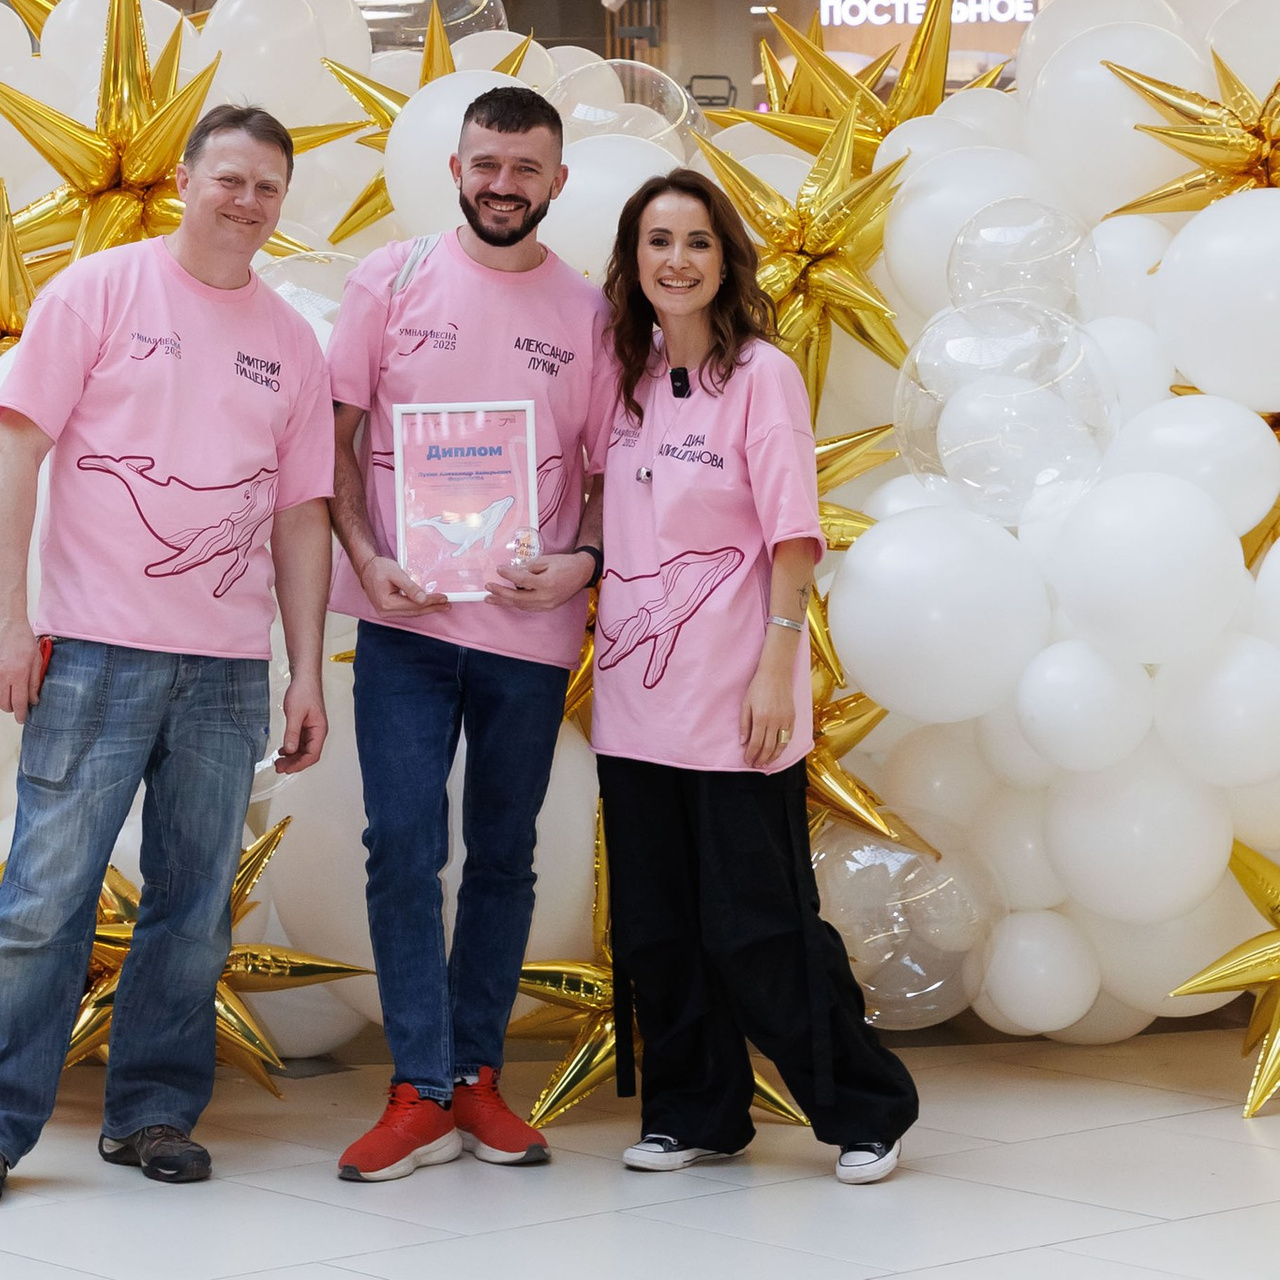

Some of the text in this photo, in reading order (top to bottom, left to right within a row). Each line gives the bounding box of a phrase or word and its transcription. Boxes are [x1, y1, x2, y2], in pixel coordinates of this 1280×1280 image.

[399, 328, 457, 341] УМНАЯ ВЕСНА
[164, 345, 182, 360] 2025
[433, 340, 457, 351] 2025
[514, 336, 575, 365] АЛЕКСАНДР
[236, 351, 281, 377] ДМИТРИЙ
[528, 356, 560, 377] ЛУКИН
[234, 362, 281, 393] ТИЩЕНКО
[682, 433, 706, 447] ДИНА
[426, 445, 502, 461] Диплом
